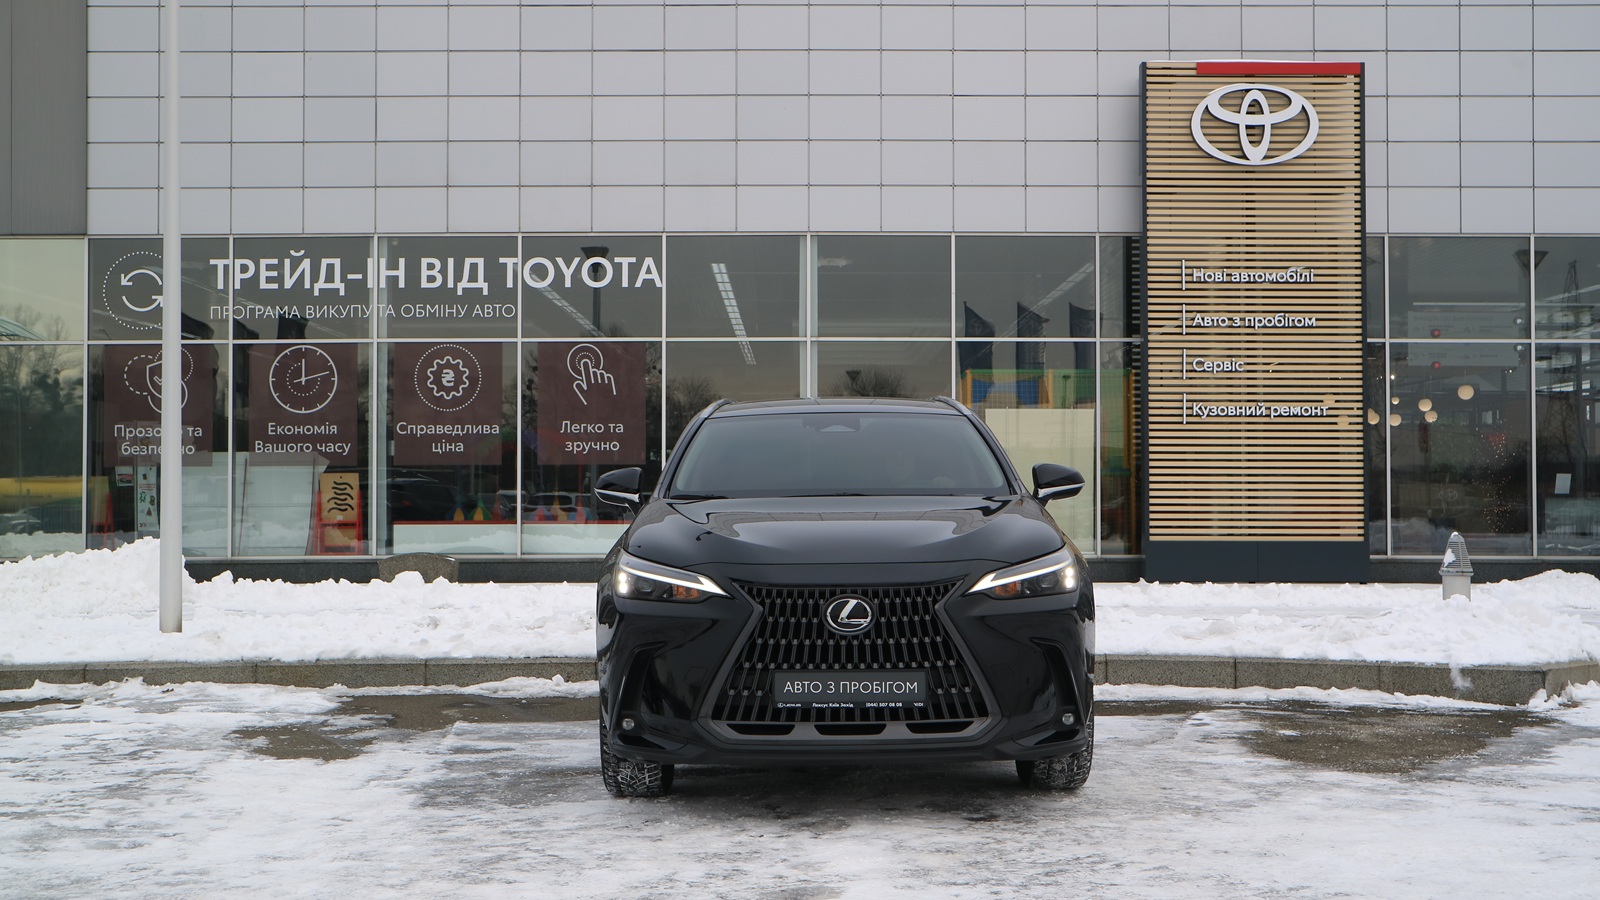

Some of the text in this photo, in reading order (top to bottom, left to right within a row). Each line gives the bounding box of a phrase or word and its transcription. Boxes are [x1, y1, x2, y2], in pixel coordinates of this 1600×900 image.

[209, 249, 663, 296] ТРЕЙД-ІН ВІД TOYOTA
[1192, 267, 1314, 283] Нові автомобілі
[210, 303, 516, 320] ПРОГРАМА ВИКУПУ ТА ОБМІНУ АВТО
[1192, 312, 1316, 330] Авто з пробігом
[1192, 357, 1244, 374] Сервіс
[1192, 402, 1329, 419] Кузовний ремонт
[114, 424, 203, 440] Прозо та
[267, 422, 338, 435] Економія
[396, 422, 500, 438] Справедлива
[560, 420, 624, 433] Легко та
[254, 440, 351, 456] Вашого часу
[432, 440, 464, 453] ціна
[565, 441, 620, 453] зручно
[783, 681, 918, 694] АВТО З ПРОБІГОМ
